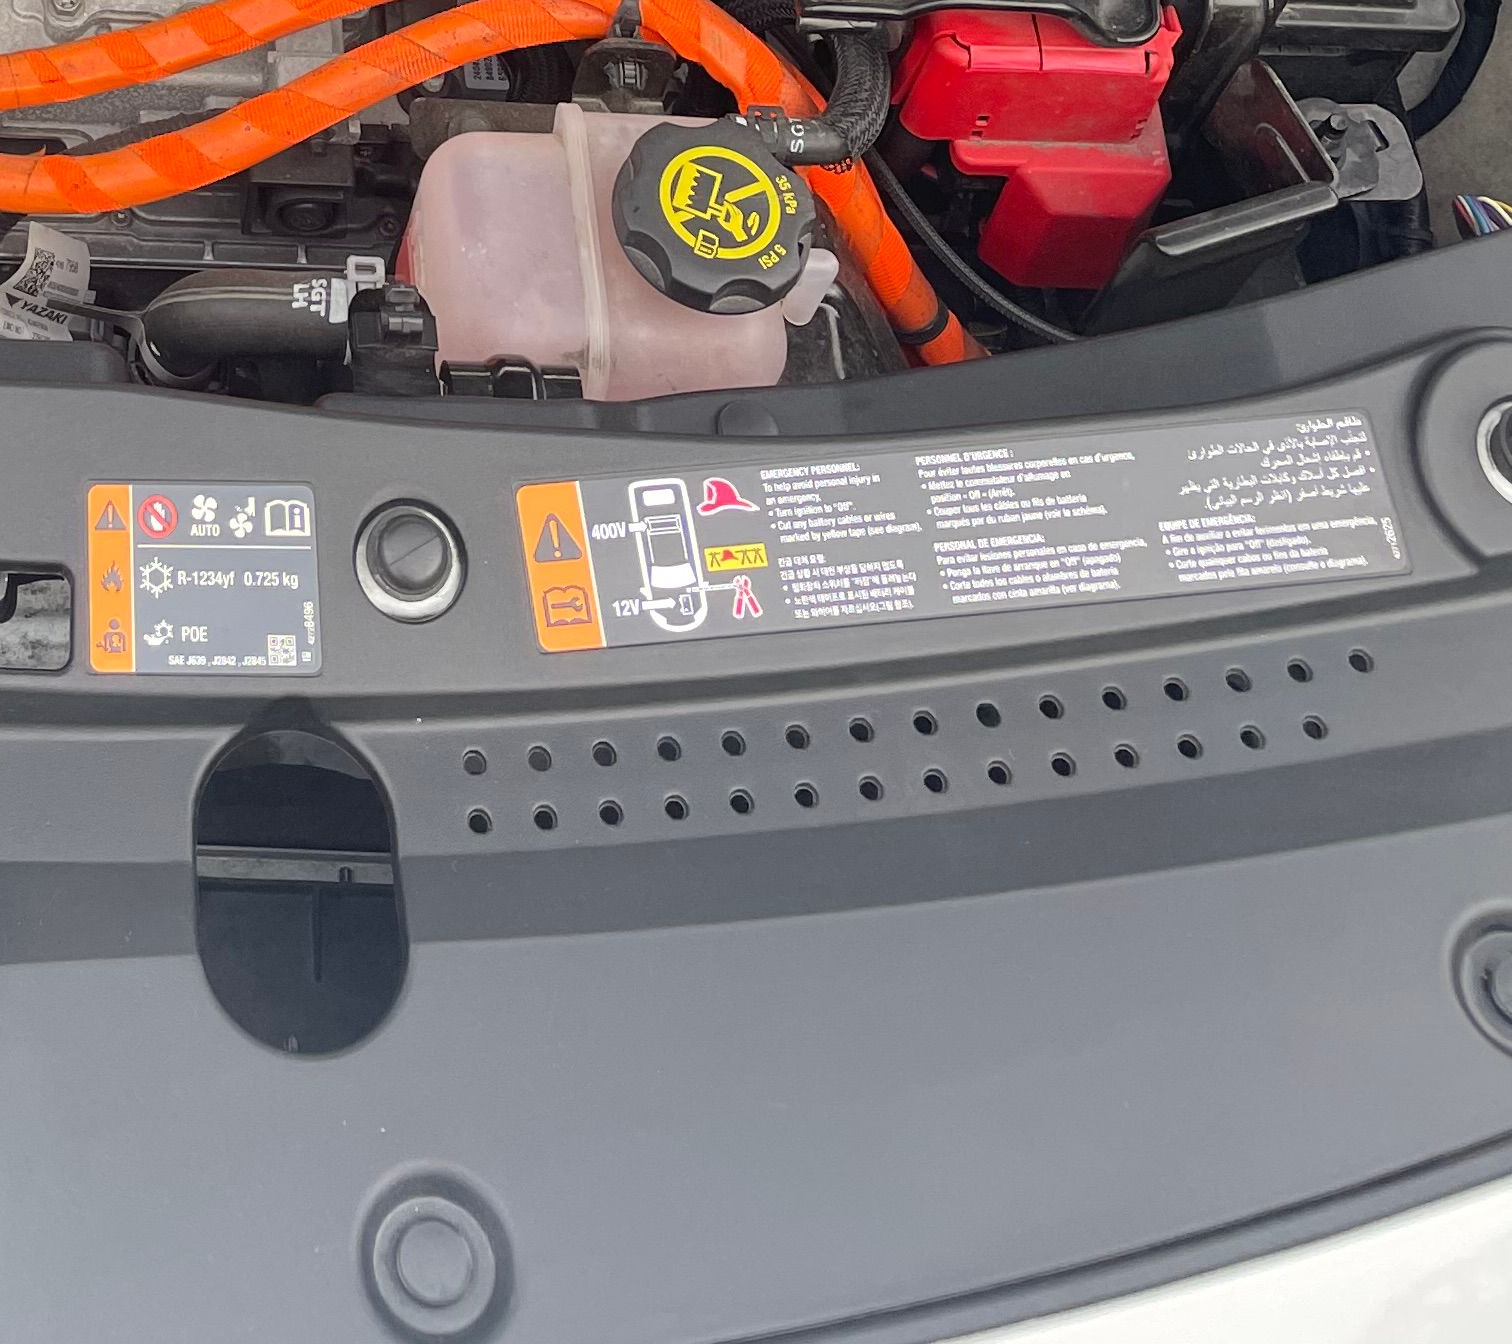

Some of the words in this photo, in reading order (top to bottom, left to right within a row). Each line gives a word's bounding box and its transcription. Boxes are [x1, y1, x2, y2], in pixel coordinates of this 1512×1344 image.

[776, 175, 792, 191] 35
[783, 192, 798, 215] kPa
[775, 243, 787, 256] 5
[758, 251, 780, 270] PSI
[292, 283, 309, 309] LH
[310, 279, 327, 317] SGT
[20, 300, 68, 325] YAZAKI
[914, 452, 963, 465] PERSONNEL
[962, 448, 1009, 461] D'URGENCE
[759, 466, 809, 479] EMERGENCY
[917, 468, 936, 478] Pour
[960, 463, 985, 474] toutes
[985, 460, 1023, 472] blessures
[1022, 456, 1067, 470] corporelles
[1067, 456, 1078, 465] en
[1078, 455, 1093, 464] cas
[762, 482, 773, 492] To
[772, 481, 791, 493] help
[791, 479, 813, 489] avoid
[813, 476, 848, 489] personal
[847, 473, 871, 486] injury
[871, 473, 880, 482] in
[964, 474, 1015, 487] commutateur
[929, 492, 962, 504] position
[774, 507, 793, 517] Turn
[793, 504, 823, 517] ignition
[823, 503, 832, 512] to
[962, 503, 980, 512] tous
[979, 501, 993, 511] les
[777, 520, 791, 530] Cut
[792, 520, 808, 530] any
[807, 516, 836, 528] battery
[836, 513, 863, 524] cables
[863, 514, 872, 522] or
[873, 510, 896, 521] wires
[971, 517, 985, 527] par
[985, 514, 996, 524] du
[997, 513, 1020, 523] ruban
[1157, 519, 1188, 531] EQUIPE
[1187, 518, 1200, 528] DE
[191, 524, 220, 537] AUTO
[592, 522, 626, 540] 400V
[779, 532, 810, 543] marked
[810, 532, 821, 542] by
[821, 528, 848, 541] yellow
[847, 526, 867, 538] tape
[932, 539, 977, 552] PERSONAL
[976, 537, 990, 548] DE
[935, 554, 955, 565] Para
[955, 552, 979, 563] evitar
[978, 549, 1012, 561] lesiones
[178, 570, 235, 588] R-1234yf
[244, 572, 279, 586] 0.725
[282, 571, 299, 590] kg
[612, 599, 640, 617] 12V
[181, 626, 208, 642] POE
[168, 655, 185, 665] SAE
